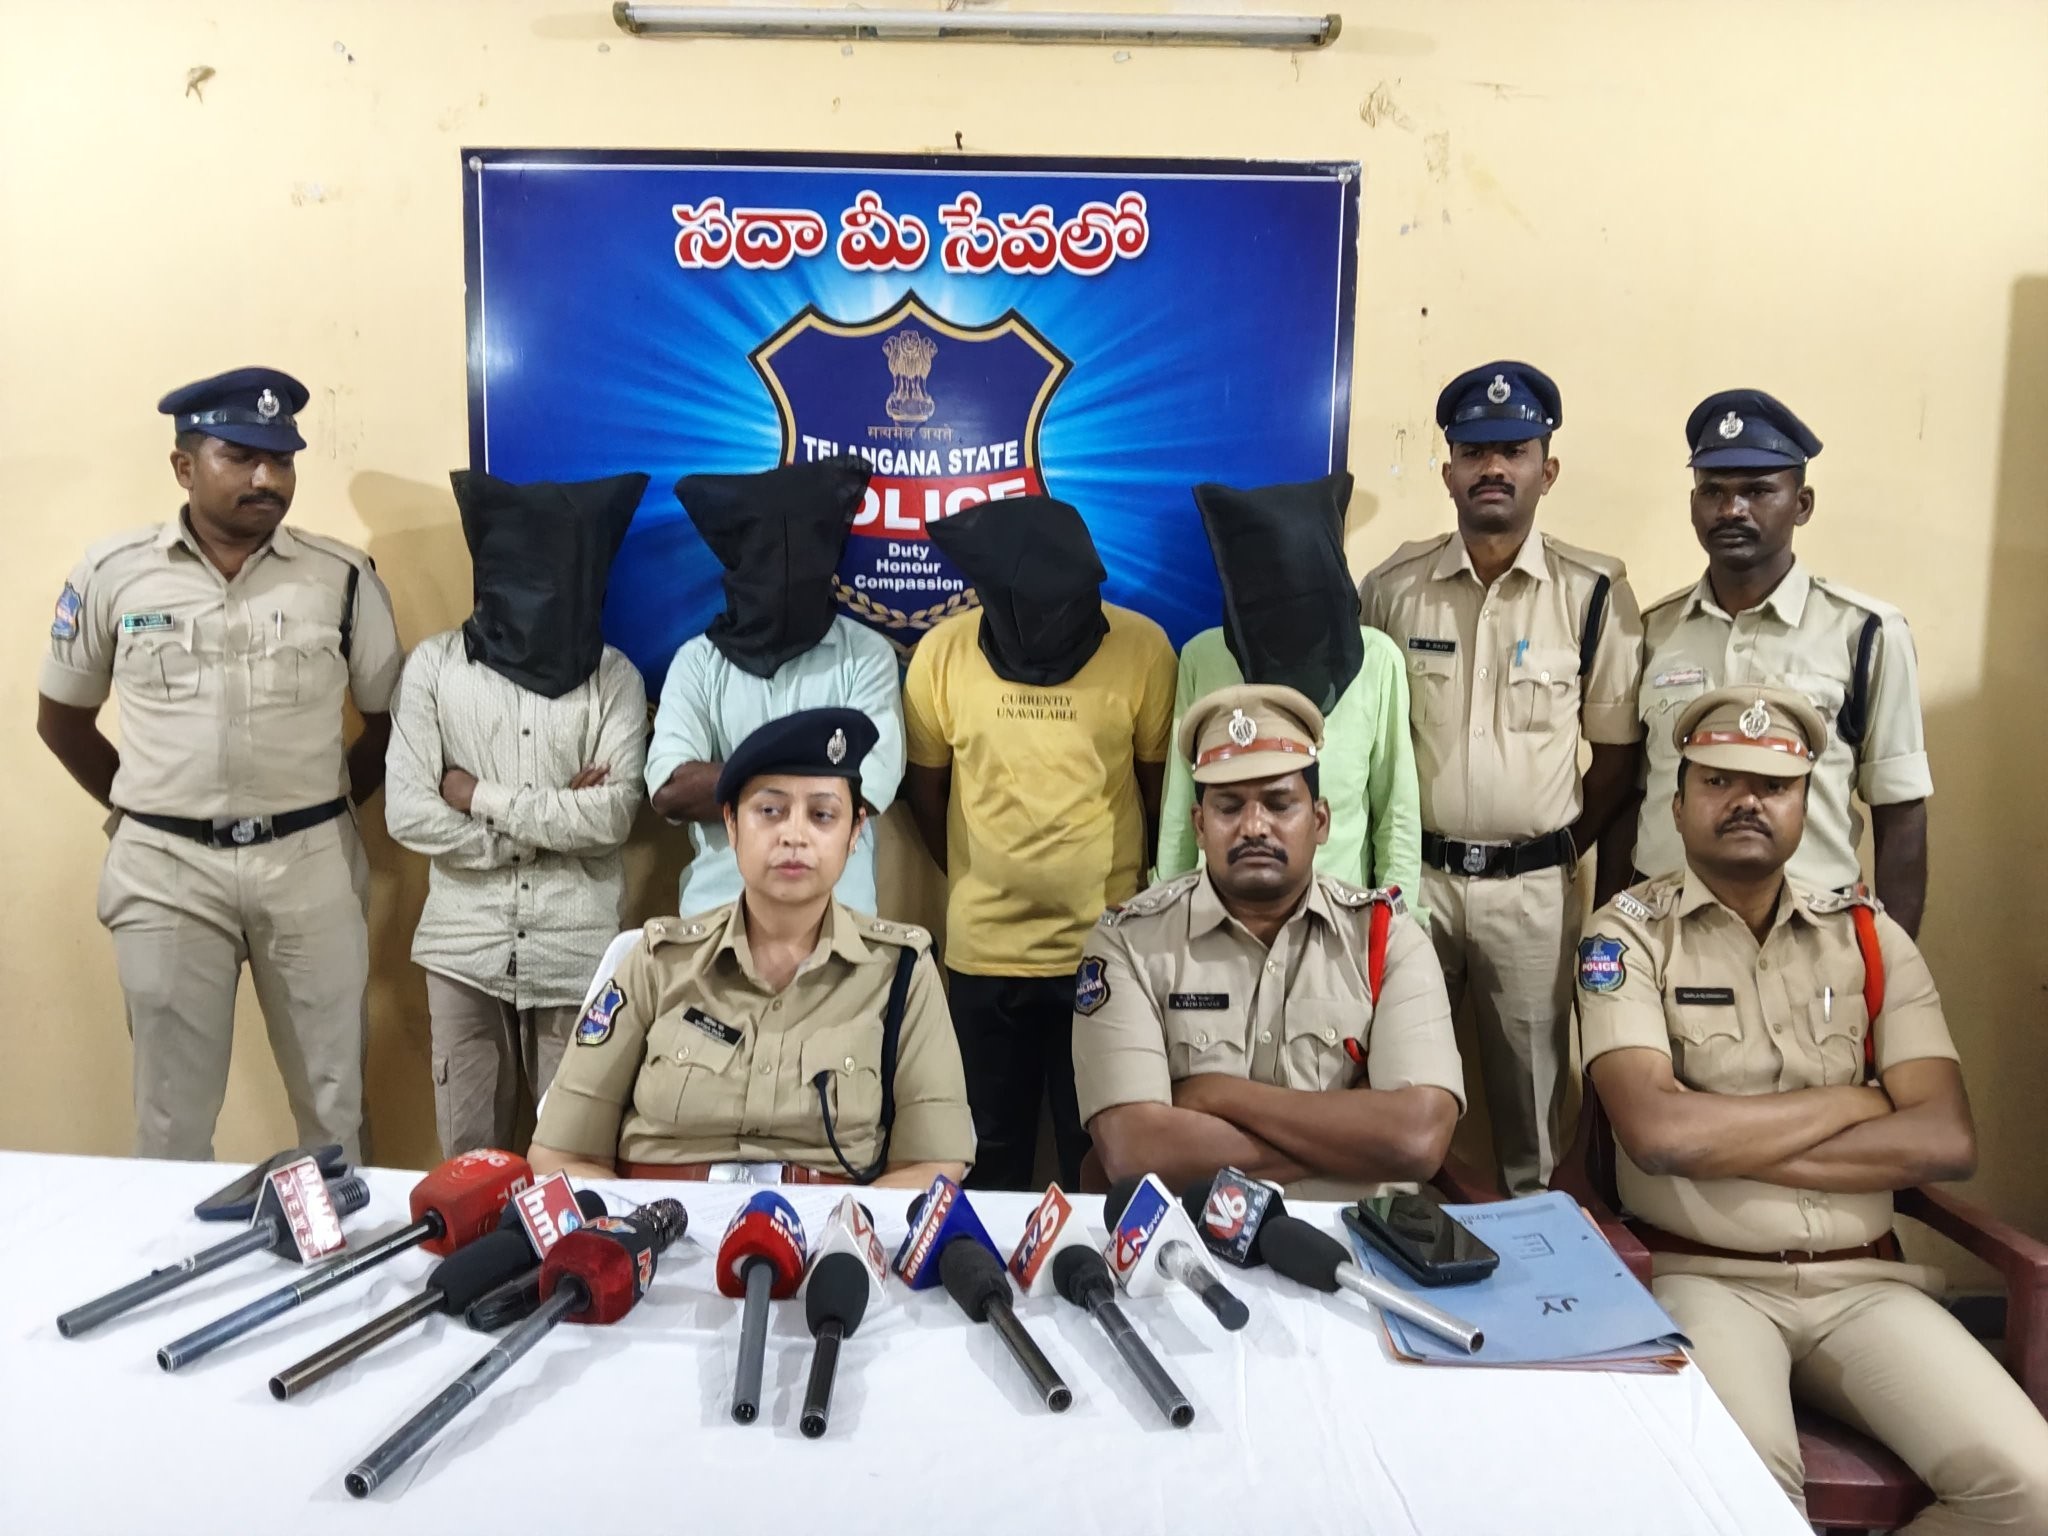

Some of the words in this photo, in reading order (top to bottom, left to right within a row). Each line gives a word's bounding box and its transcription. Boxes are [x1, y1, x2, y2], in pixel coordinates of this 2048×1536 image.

[673, 197, 826, 270] సదా
[837, 190, 930, 271] మీ
[939, 191, 1149, 275] సేవలో
[948, 440, 1018, 475] STATE
[888, 542, 929, 560] Duty
[876, 558, 941, 574] Honour
[854, 574, 964, 593] Compassion
[1001, 694, 1072, 707] CURRENTLY
[996, 707, 1077, 721] UNAVAILABLE
[1582, 961, 1619, 973] POLICE
[1206, 1190, 1247, 1229] V6
[1236, 1195, 1264, 1251] NEWS
[906, 1216, 941, 1280] MUNSIF
[937, 1189, 952, 1215] TV
